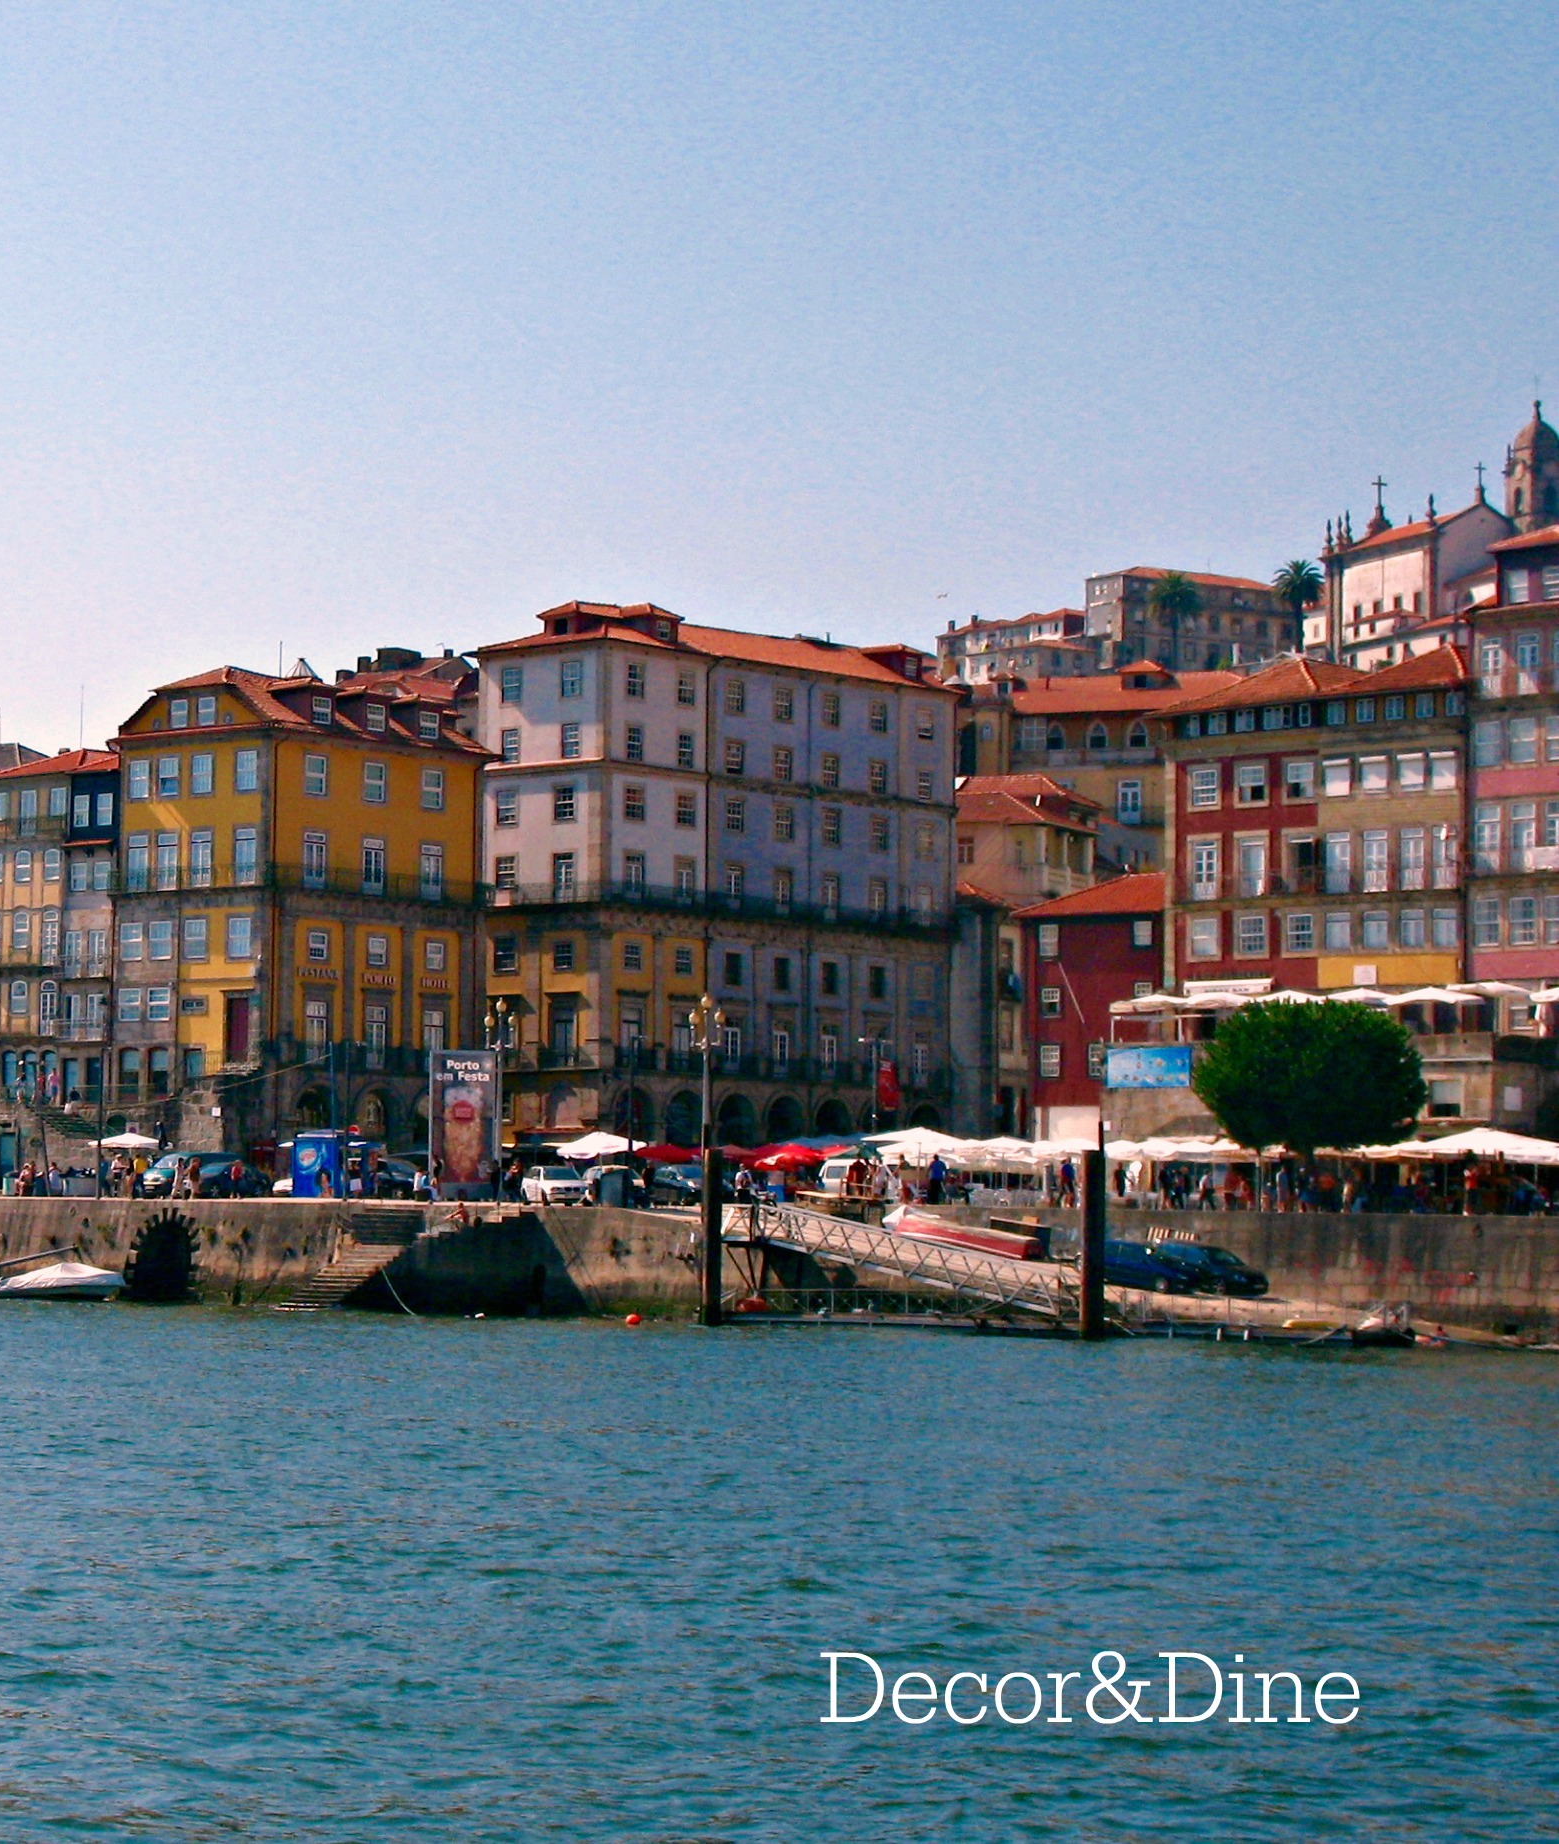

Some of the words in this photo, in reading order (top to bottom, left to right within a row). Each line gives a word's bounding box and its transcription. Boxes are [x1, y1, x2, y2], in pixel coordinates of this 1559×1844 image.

[361, 972, 396, 986] PORTO
[446, 1059, 480, 1070] Porto
[436, 1072, 454, 1081] em
[457, 1070, 490, 1082] Festa
